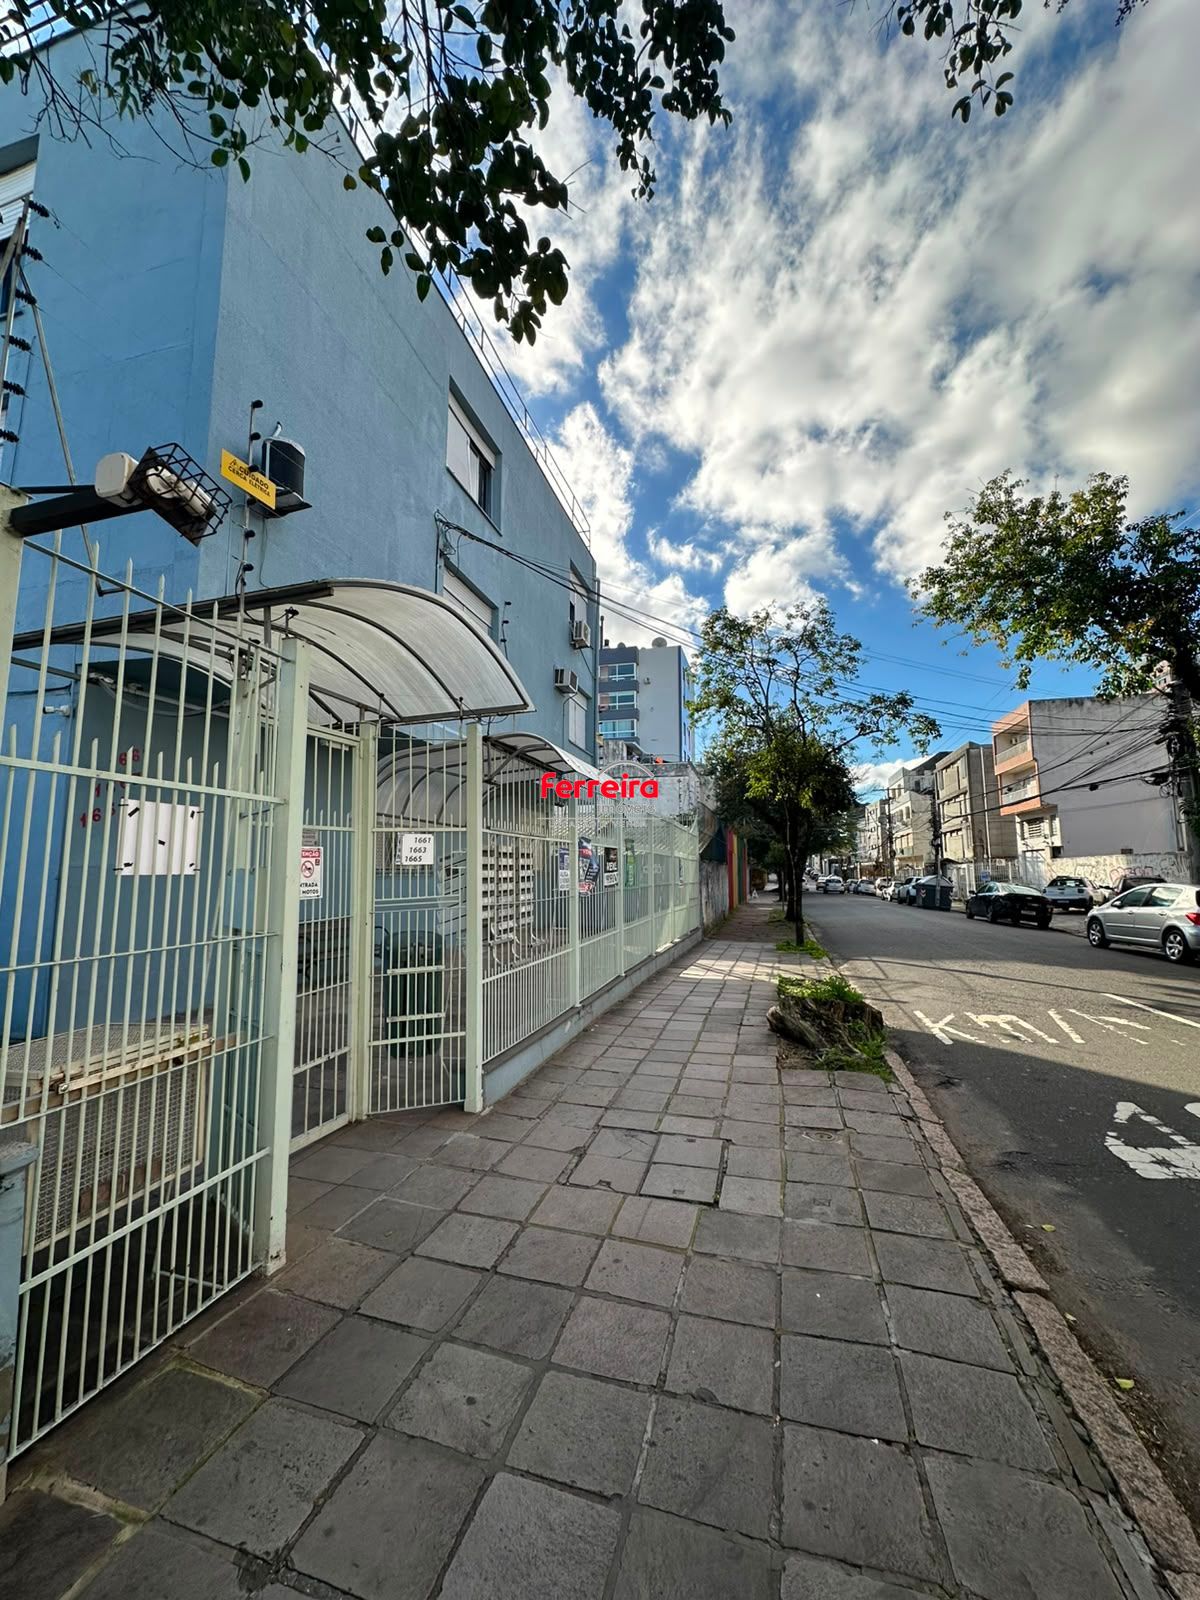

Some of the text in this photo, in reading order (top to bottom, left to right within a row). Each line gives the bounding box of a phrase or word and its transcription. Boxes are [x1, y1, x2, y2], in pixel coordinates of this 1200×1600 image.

[228, 465, 248, 481] CERCA
[414, 836, 432, 844] 1661
[409, 846, 427, 854] 1663
[404, 855, 423, 863] 1665
